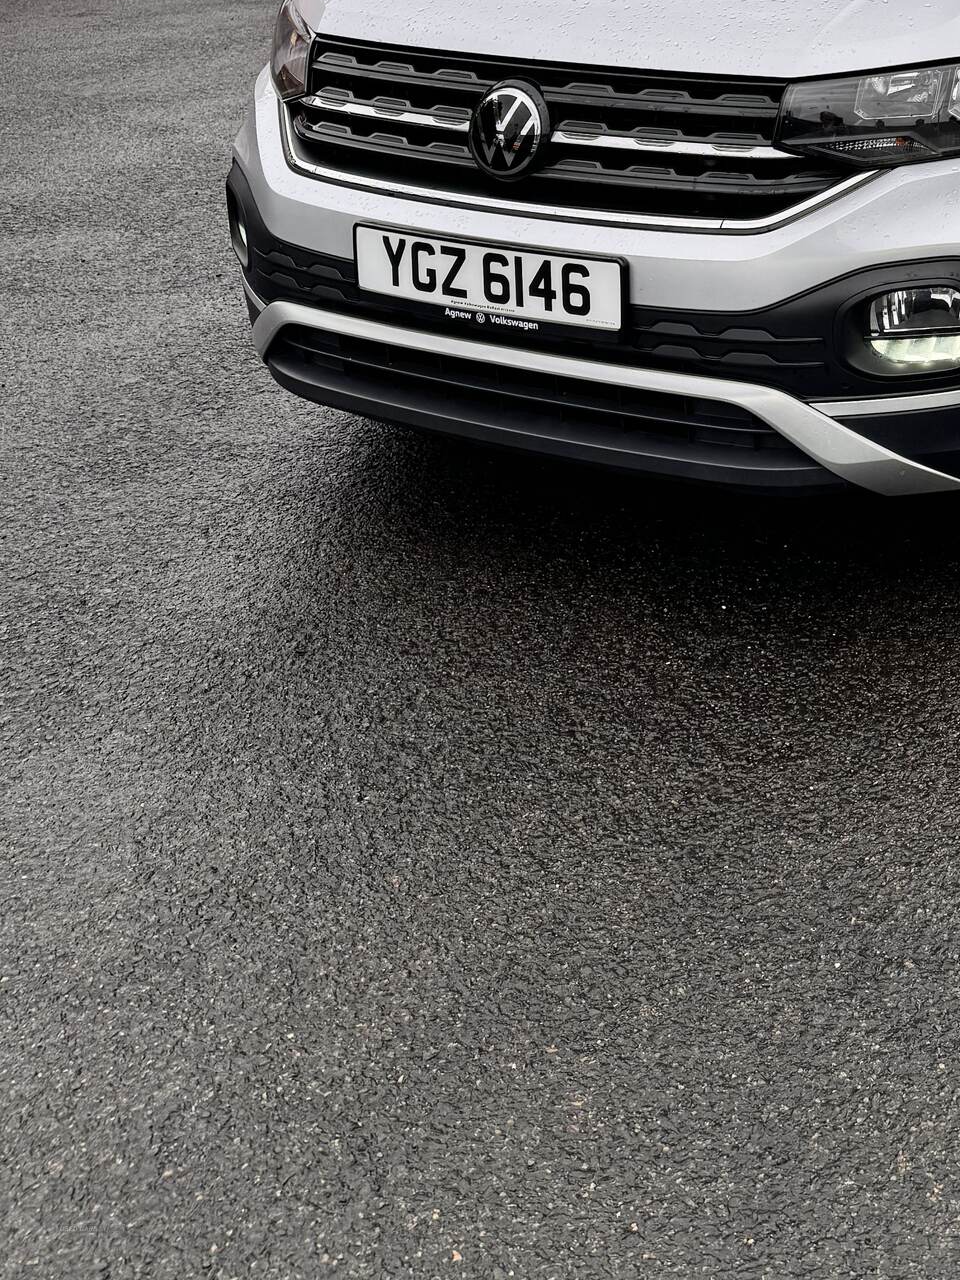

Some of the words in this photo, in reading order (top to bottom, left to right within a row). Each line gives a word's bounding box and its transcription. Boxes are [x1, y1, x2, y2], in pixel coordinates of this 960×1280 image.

[382, 235, 468, 299] YGZ
[482, 252, 591, 316] 6146
[444, 307, 472, 320] Agnew
[490, 314, 539, 330] Volkswagen
